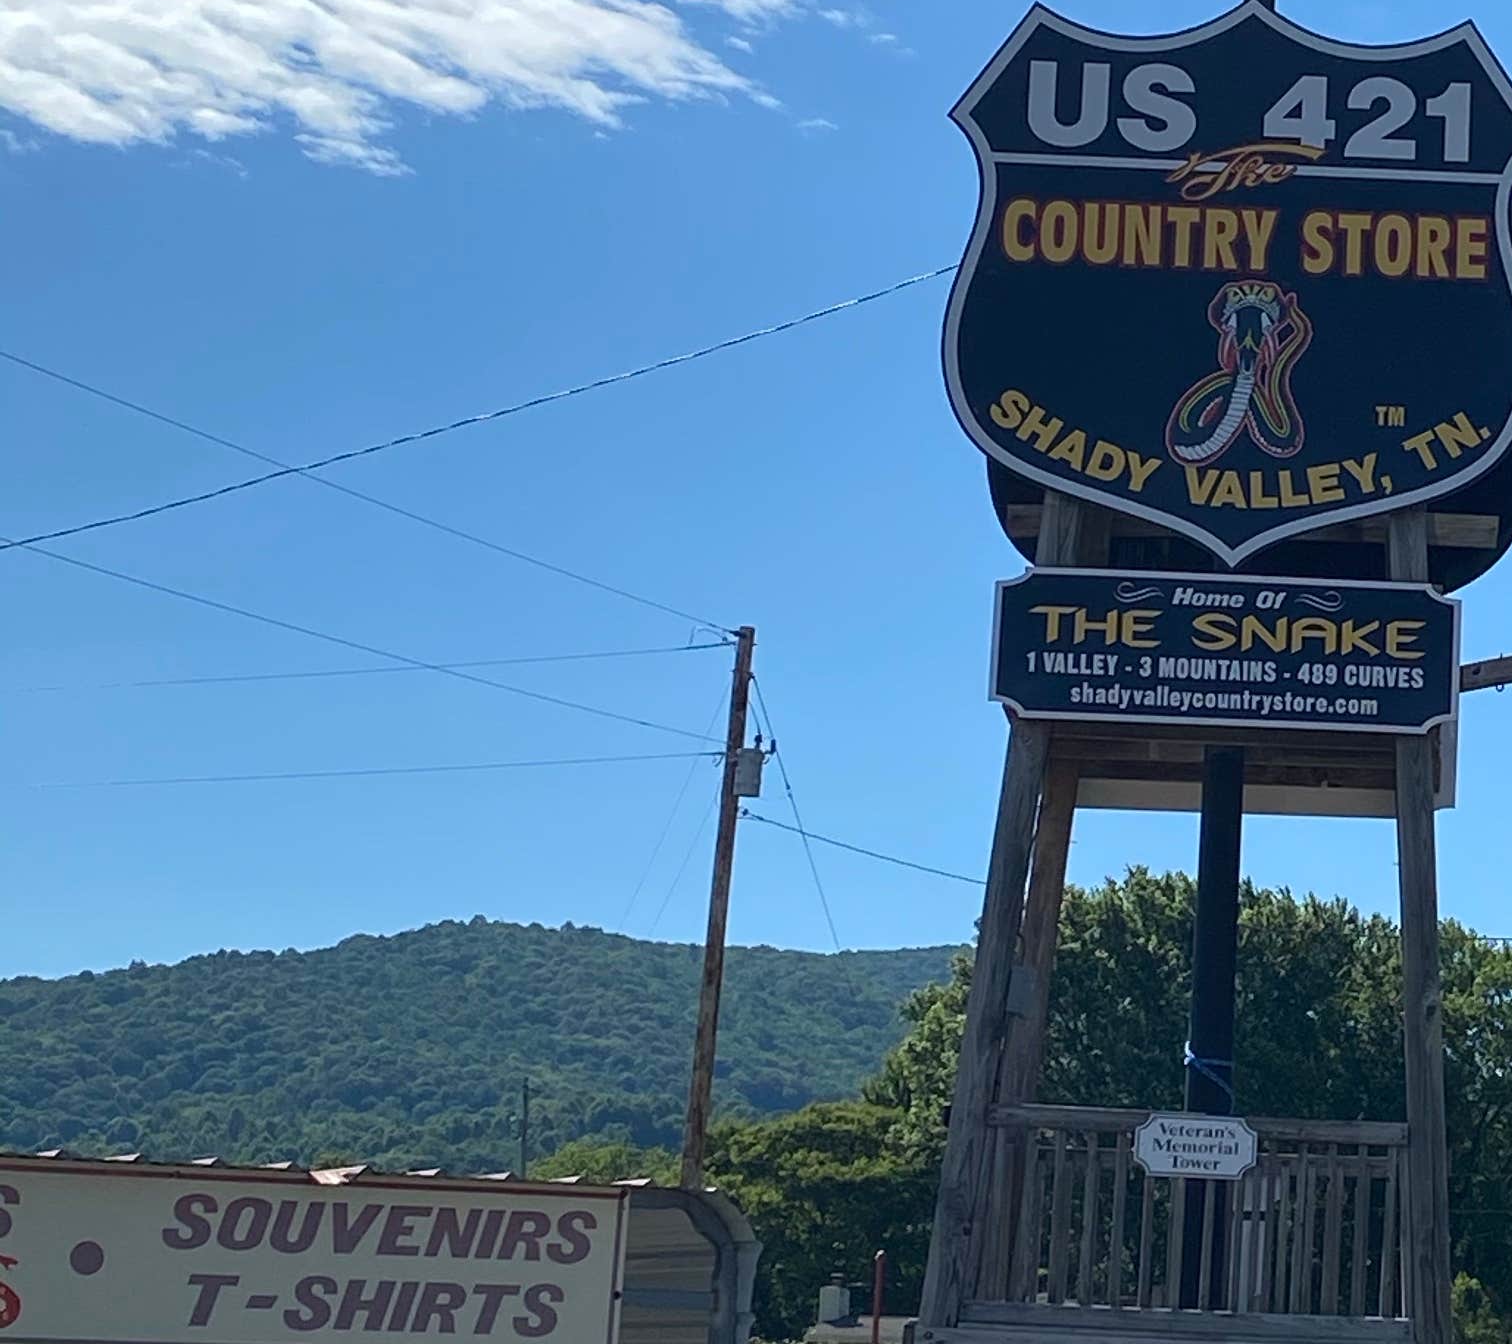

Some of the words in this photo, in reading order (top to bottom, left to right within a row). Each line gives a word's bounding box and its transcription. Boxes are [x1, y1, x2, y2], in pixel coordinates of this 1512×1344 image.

[1026, 60, 1198, 153] US
[1263, 75, 1473, 164] 421
[1165, 144, 1326, 201] The
[1001, 198, 1279, 273] COUNTRY
[1301, 210, 1489, 280] STORE
[988, 389, 1163, 494] SHADY
[1184, 453, 1393, 510] VALLEY,
[1402, 412, 1492, 472] TN.
[1171, 587, 1244, 609] Home
[1255, 589, 1286, 611] Of
[1027, 604, 1165, 648] THE
[1190, 611, 1427, 660] SNAKE
[1026, 652, 1037, 673] 1
[1042, 652, 1120, 676] VALLEY
[1138, 656, 1152, 677] 3
[1158, 656, 1277, 684] MOUNTAINS
[1297, 663, 1339, 686] 489
[1343, 665, 1425, 689] CURVES
[1070, 681, 1379, 716] shadyvalleycountrystore.com
[1152, 1138, 1240, 1156] Memorial
[1158, 1122, 1237, 1140] Veteran's
[1171, 1155, 1222, 1171] Tower
[161, 1192, 598, 1265] SOUVENIRS
[187, 1274, 564, 1339] T-SHIRTS
